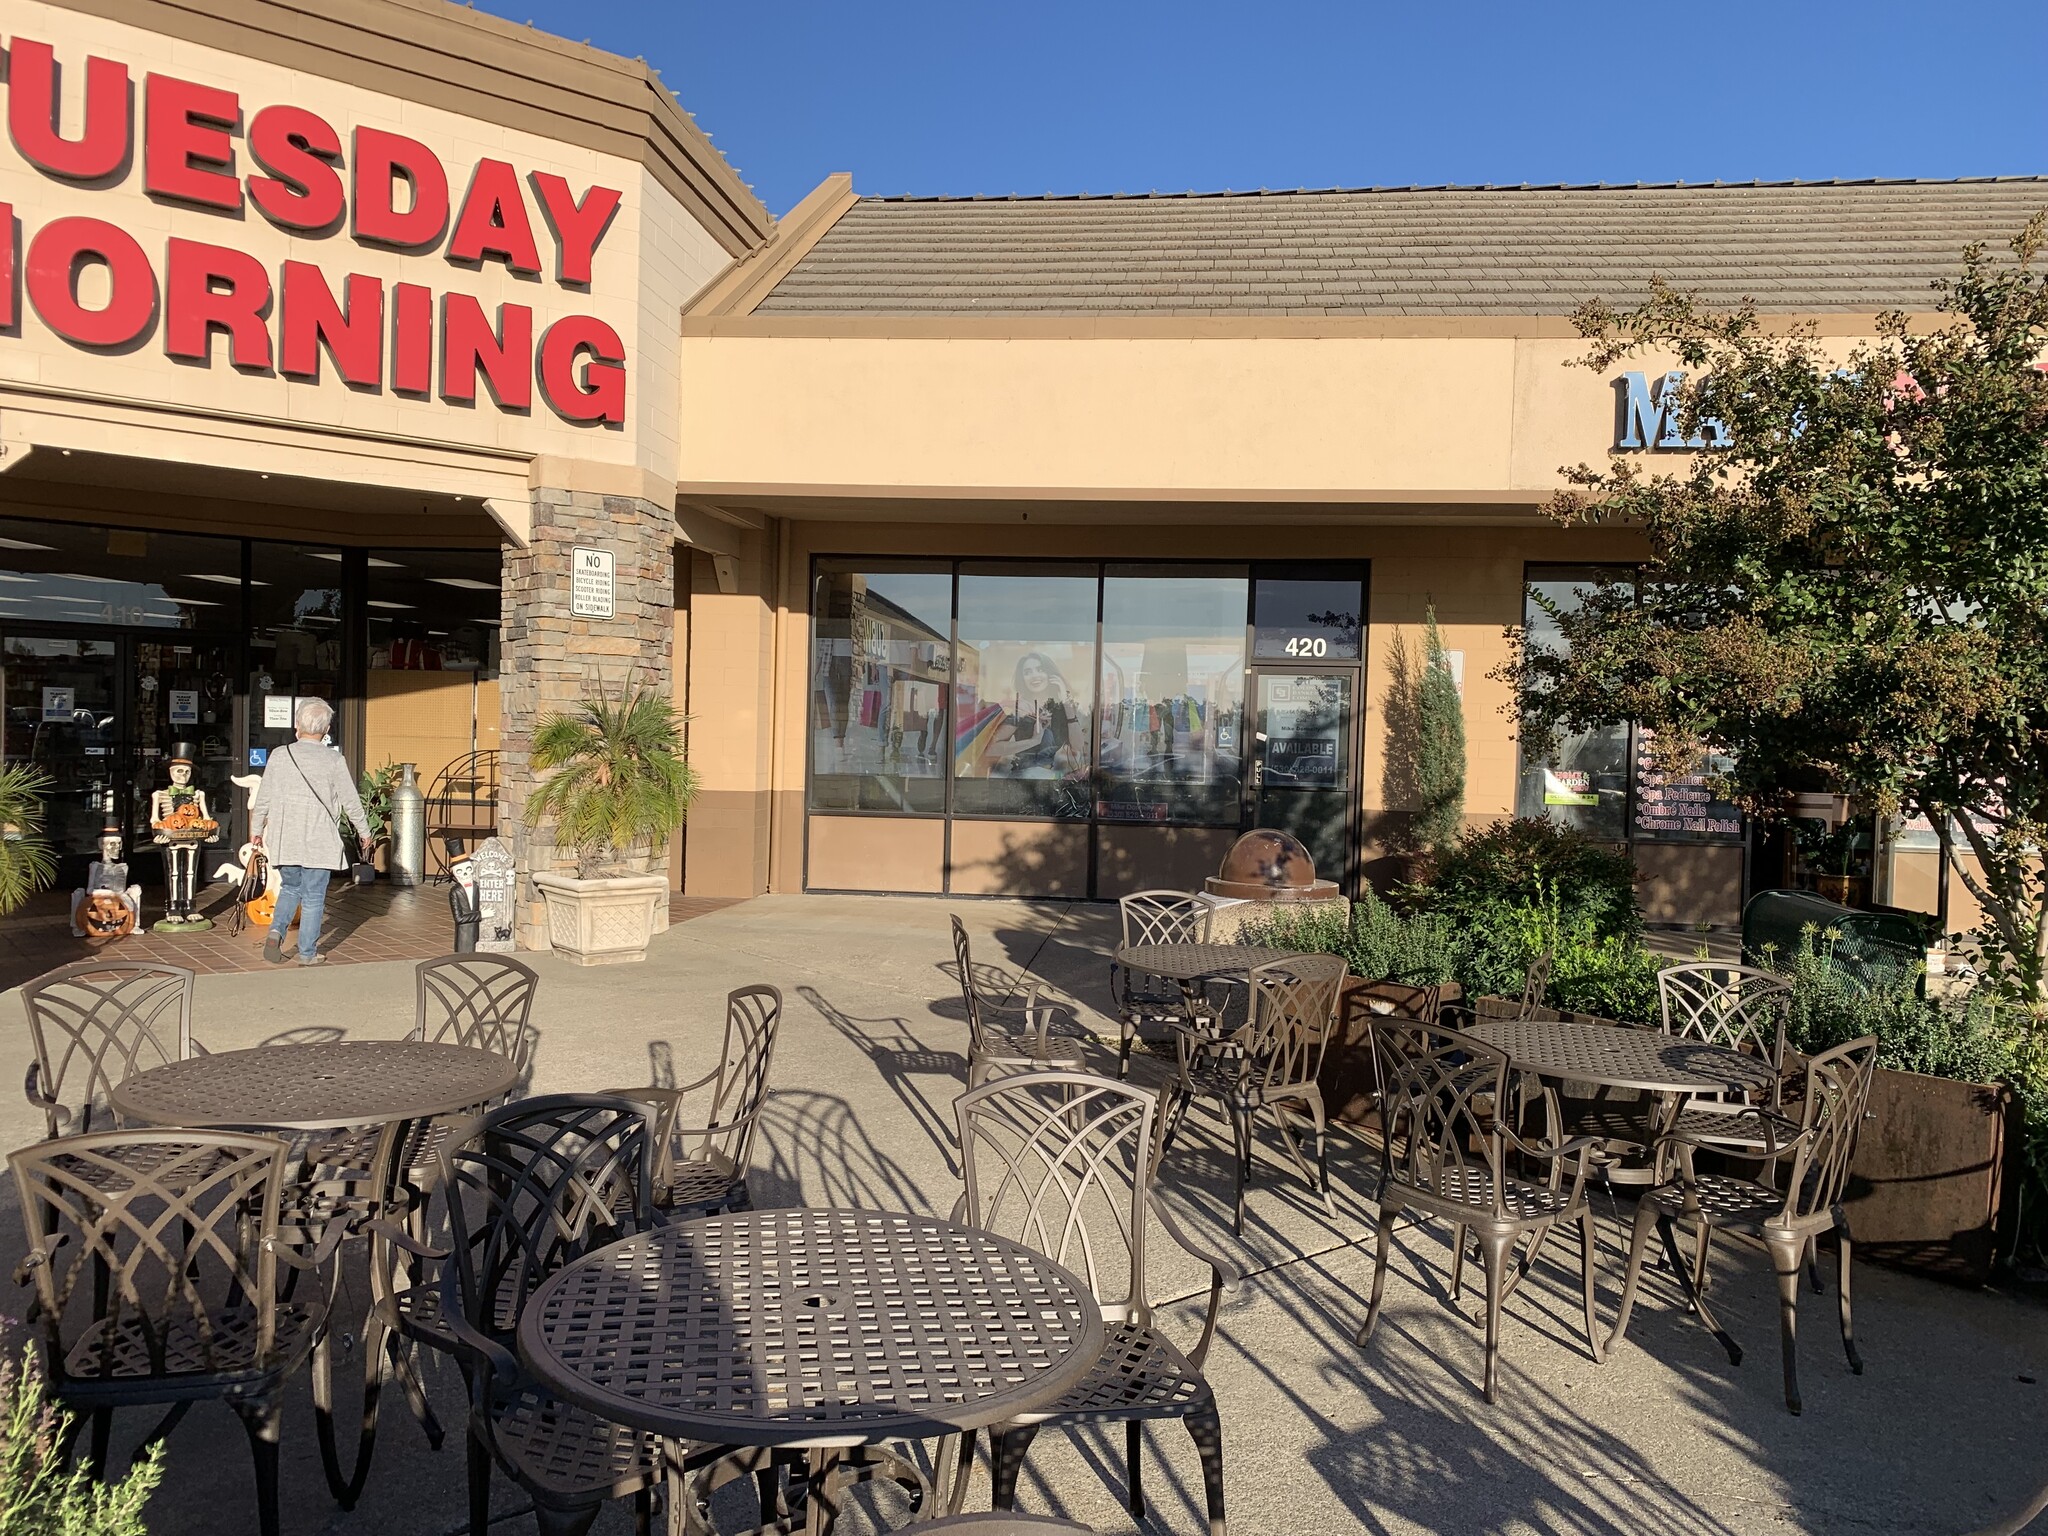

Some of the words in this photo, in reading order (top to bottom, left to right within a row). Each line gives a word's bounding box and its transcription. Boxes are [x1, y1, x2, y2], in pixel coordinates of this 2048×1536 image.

[0, 33, 622, 288] UESDAY
[0, 198, 626, 426] ORNING
[586, 555, 601, 568] NO
[576, 569, 611, 578] SKATEBOARDING
[576, 577, 594, 585] BICYCLE
[575, 586, 595, 594] SCOOTER
[575, 594, 592, 602] ROLLER
[593, 596, 611, 604] BLADING
[100, 604, 145, 625] 410
[585, 604, 610, 613] SIDEWALK
[1285, 637, 1327, 657] 420
[1272, 742, 1334, 755] AVAILABLE
[1665, 787, 1711, 802] Pedicure
[1679, 803, 1707, 816] Nails
[1683, 818, 1706, 831] Nail
[1707, 819, 1740, 833] Polish
[475, 850, 508, 863] WELCOME
[479, 879, 504, 889] ENTER
[479, 889, 503, 901] HERE
